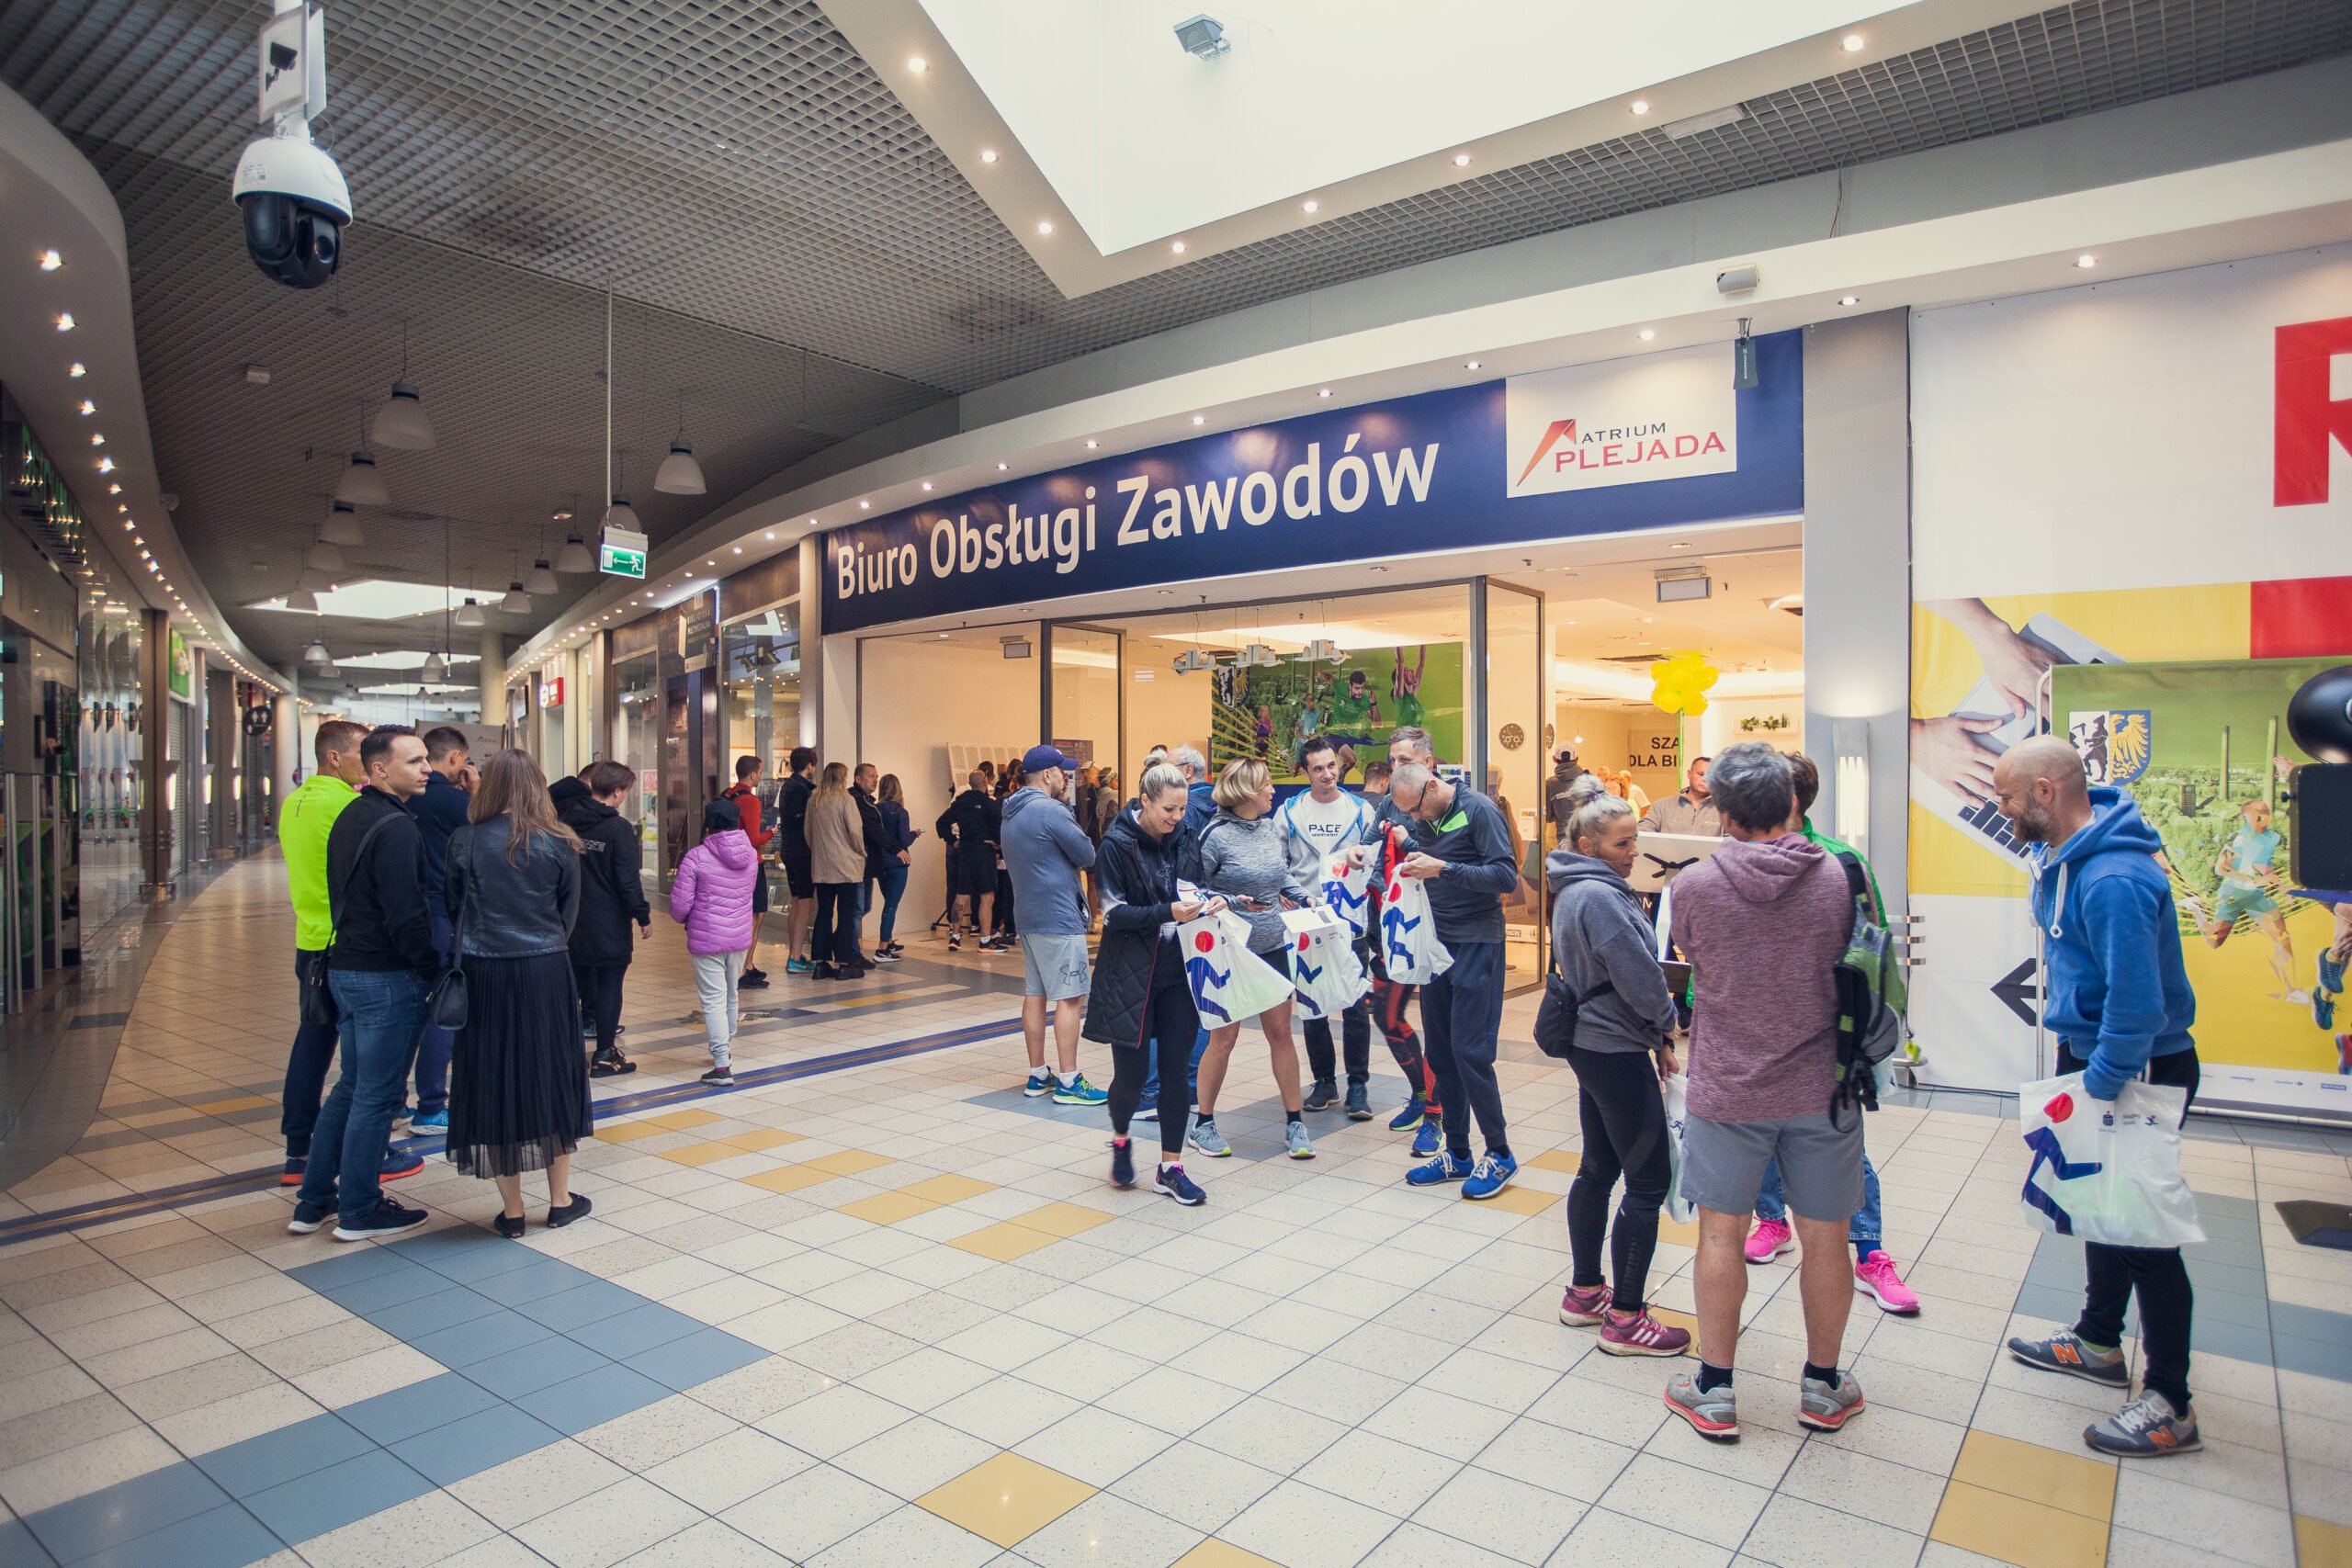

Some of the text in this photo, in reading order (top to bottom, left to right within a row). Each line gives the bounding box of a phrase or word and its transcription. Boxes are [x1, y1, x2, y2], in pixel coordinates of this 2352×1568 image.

[2273, 315, 2352, 507] R
[1555, 431, 1727, 473] PLEJADA
[1581, 423, 1667, 444] ATRIUM
[837, 434, 1440, 600] Biuro Obsługi Zawodów
[1308, 824, 1342, 833] PACE
